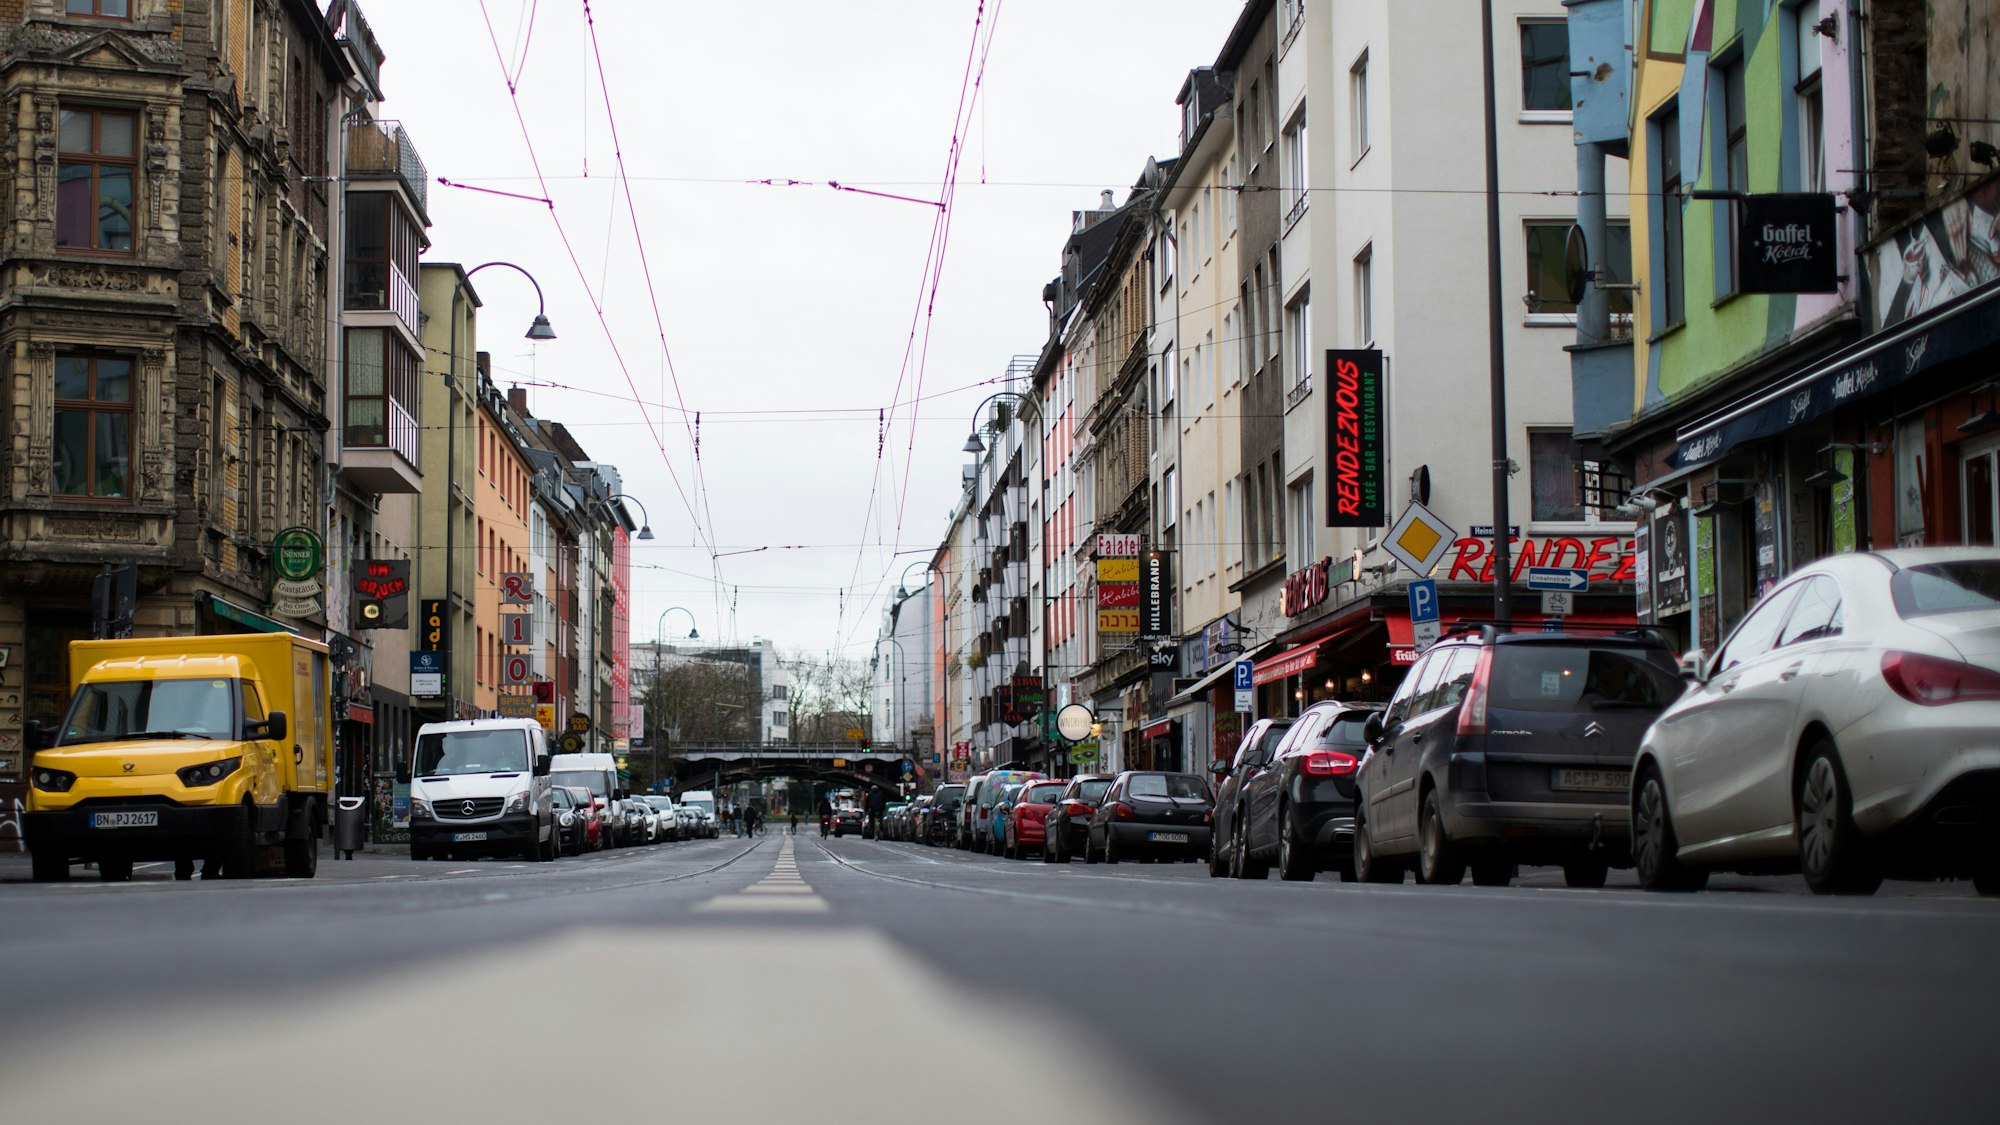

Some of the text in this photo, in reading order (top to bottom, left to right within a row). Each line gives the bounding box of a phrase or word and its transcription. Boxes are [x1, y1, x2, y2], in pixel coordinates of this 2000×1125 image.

[1763, 224, 1812, 243] Gaffel
[1762, 243, 1812, 264] Kölsch
[1336, 358, 1360, 516] RENDEZVOUS
[1364, 371, 1376, 508] CAFÉ BAR RESTAURANT
[1098, 535, 1141, 555] Falafel
[1531, 575, 1571, 583] Einbahnstraße
[1150, 558, 1160, 631] HILLEBRAND
[1415, 585, 1430, 617] P
[277, 605, 317, 615] Kleinmann
[1151, 651, 1175, 666] sky
[1237, 664, 1248, 687] P
[501, 697, 527, 705] SPIEL
[1564, 772, 1581, 785] AC
[1591, 773, 1599, 785] P
[96, 813, 156, 825] BN PJ 2617
